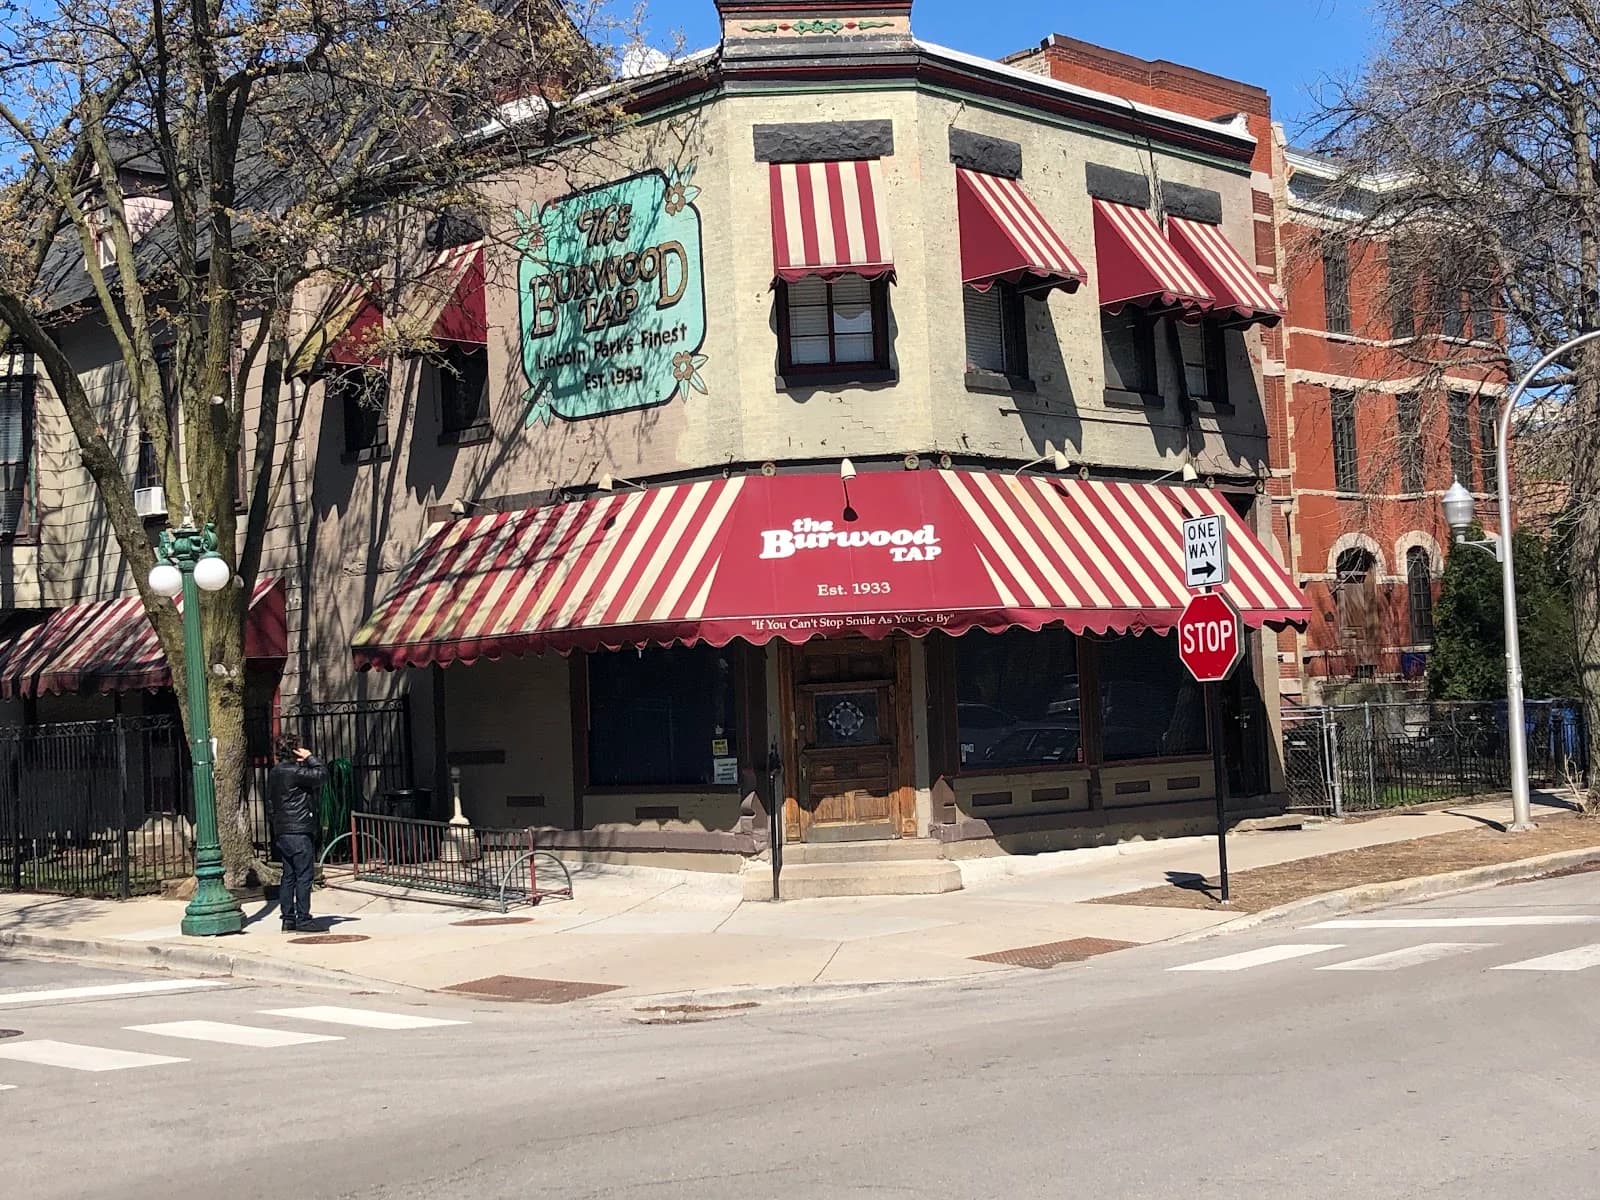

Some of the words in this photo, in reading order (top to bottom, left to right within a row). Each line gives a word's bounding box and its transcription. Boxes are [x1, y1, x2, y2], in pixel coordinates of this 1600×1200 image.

[529, 240, 689, 340] BURWOOD
[578, 289, 640, 334] TAP
[536, 345, 586, 370] Lincoln
[593, 336, 634, 360] Park's
[640, 323, 688, 349] Finest
[792, 517, 833, 533] the
[1188, 522, 1216, 541] ONE
[759, 524, 941, 560] Burwood
[1188, 541, 1217, 560] WAY
[889, 546, 942, 562] TAP
[817, 583, 848, 597] Est.
[852, 581, 891, 595] 1933
[751, 619, 764, 630] "If
[766, 619, 787, 630] You
[789, 618, 818, 629] Can't
[819, 617, 844, 630] Stop
[846, 615, 877, 626] Smile
[878, 615, 893, 625] As
[894, 614, 915, 625] You
[917, 614, 934, 624] Go
[1183, 619, 1233, 655] STOP
